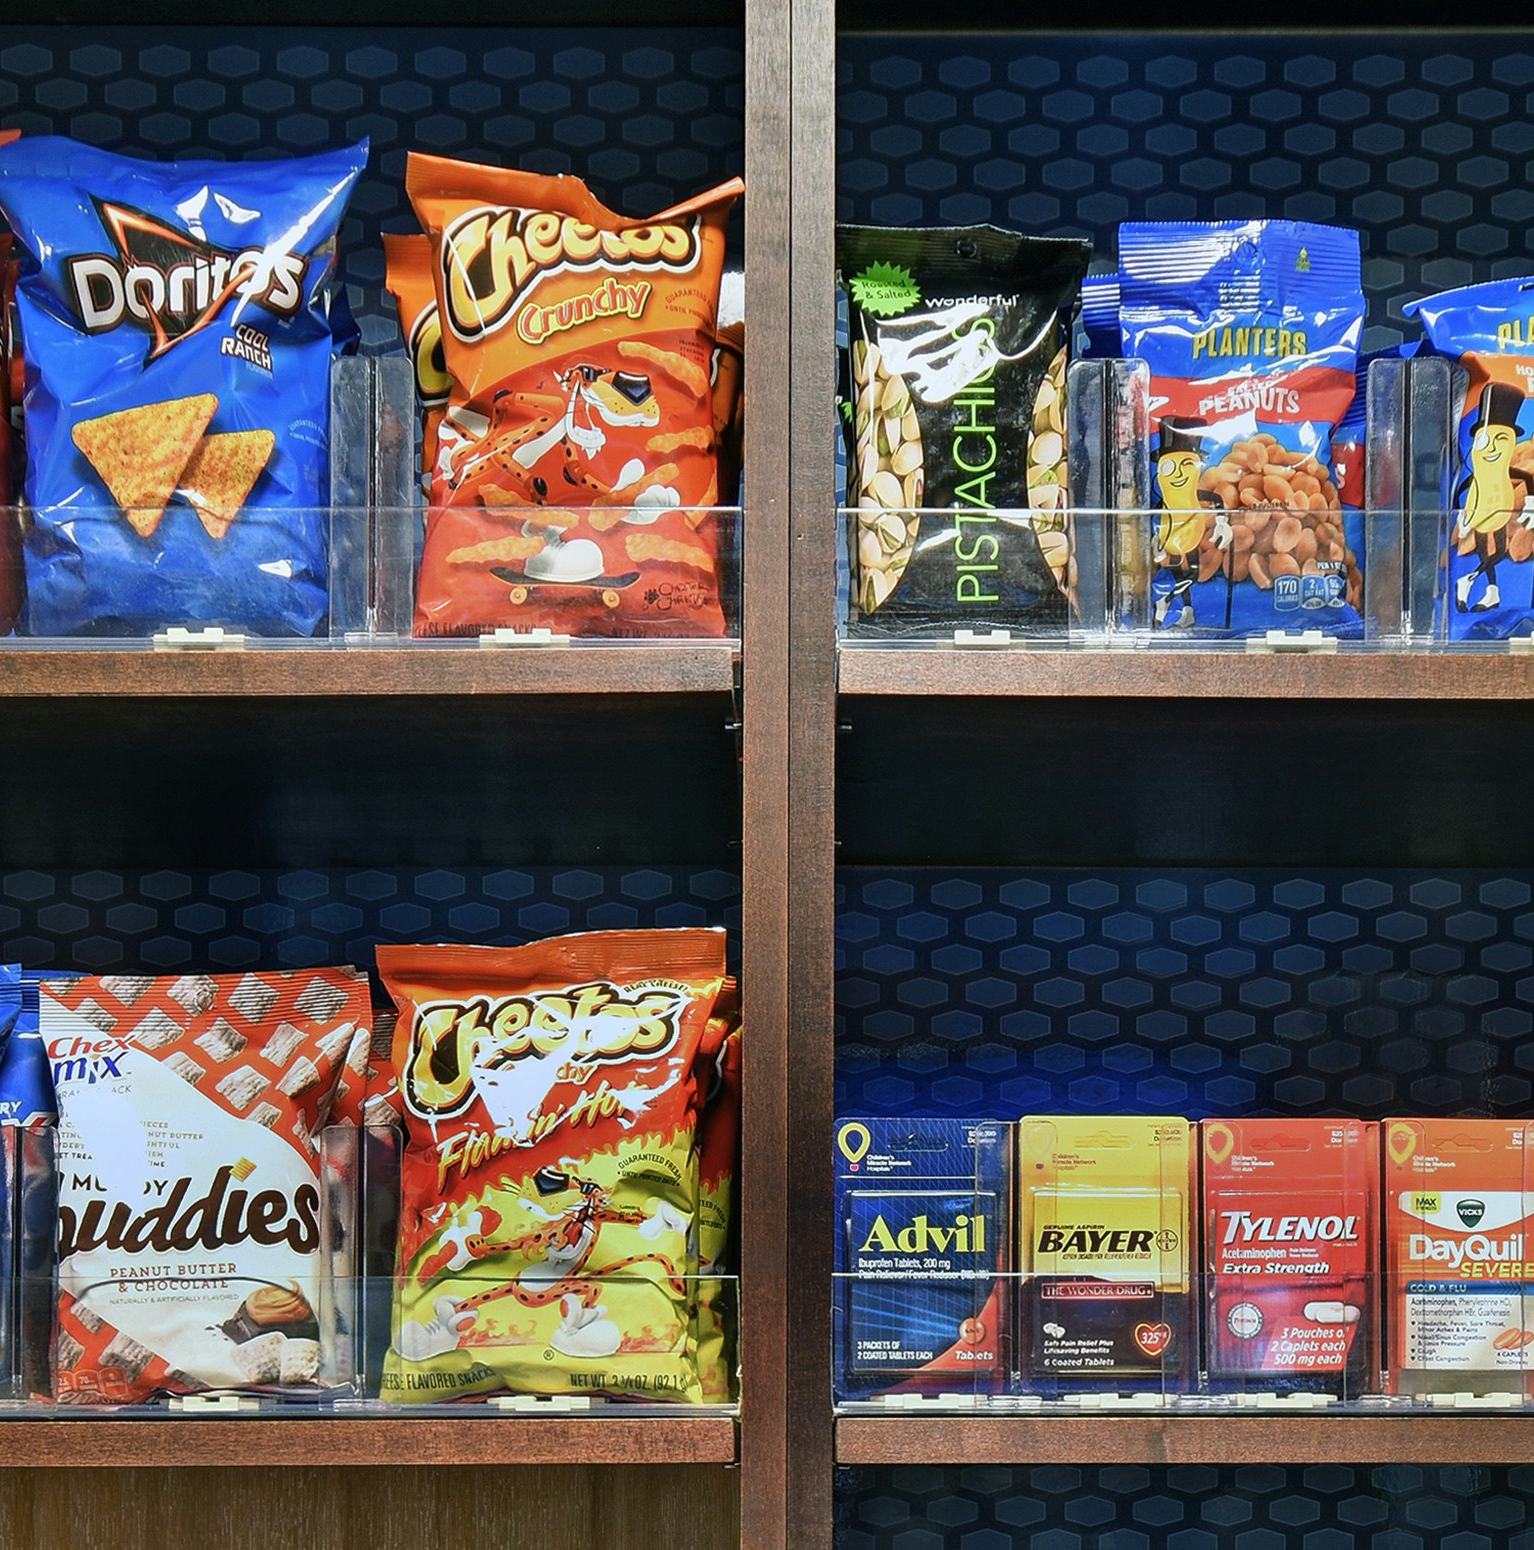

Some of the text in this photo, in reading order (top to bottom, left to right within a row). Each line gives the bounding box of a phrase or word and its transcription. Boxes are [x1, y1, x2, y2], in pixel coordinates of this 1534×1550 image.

[72, 252, 305, 328] Doritos
[925, 295, 1019, 308] Wonderful
[519, 281, 650, 343] Crunchy
[1193, 328, 1307, 358] PLANTERS
[1458, 1208, 1482, 1216] VICKS
[859, 1215, 986, 1253] Advil
[1220, 1211, 1359, 1243] TYLENOL
[1038, 1229, 1156, 1253] BAYER
[1222, 1248, 1286, 1259] Acetaminophen
[1409, 1235, 1525, 1265] DayQuil
[110, 1264, 236, 1278] PEANUT BUTTER
[1223, 1262, 1329, 1275] Extra Strength
